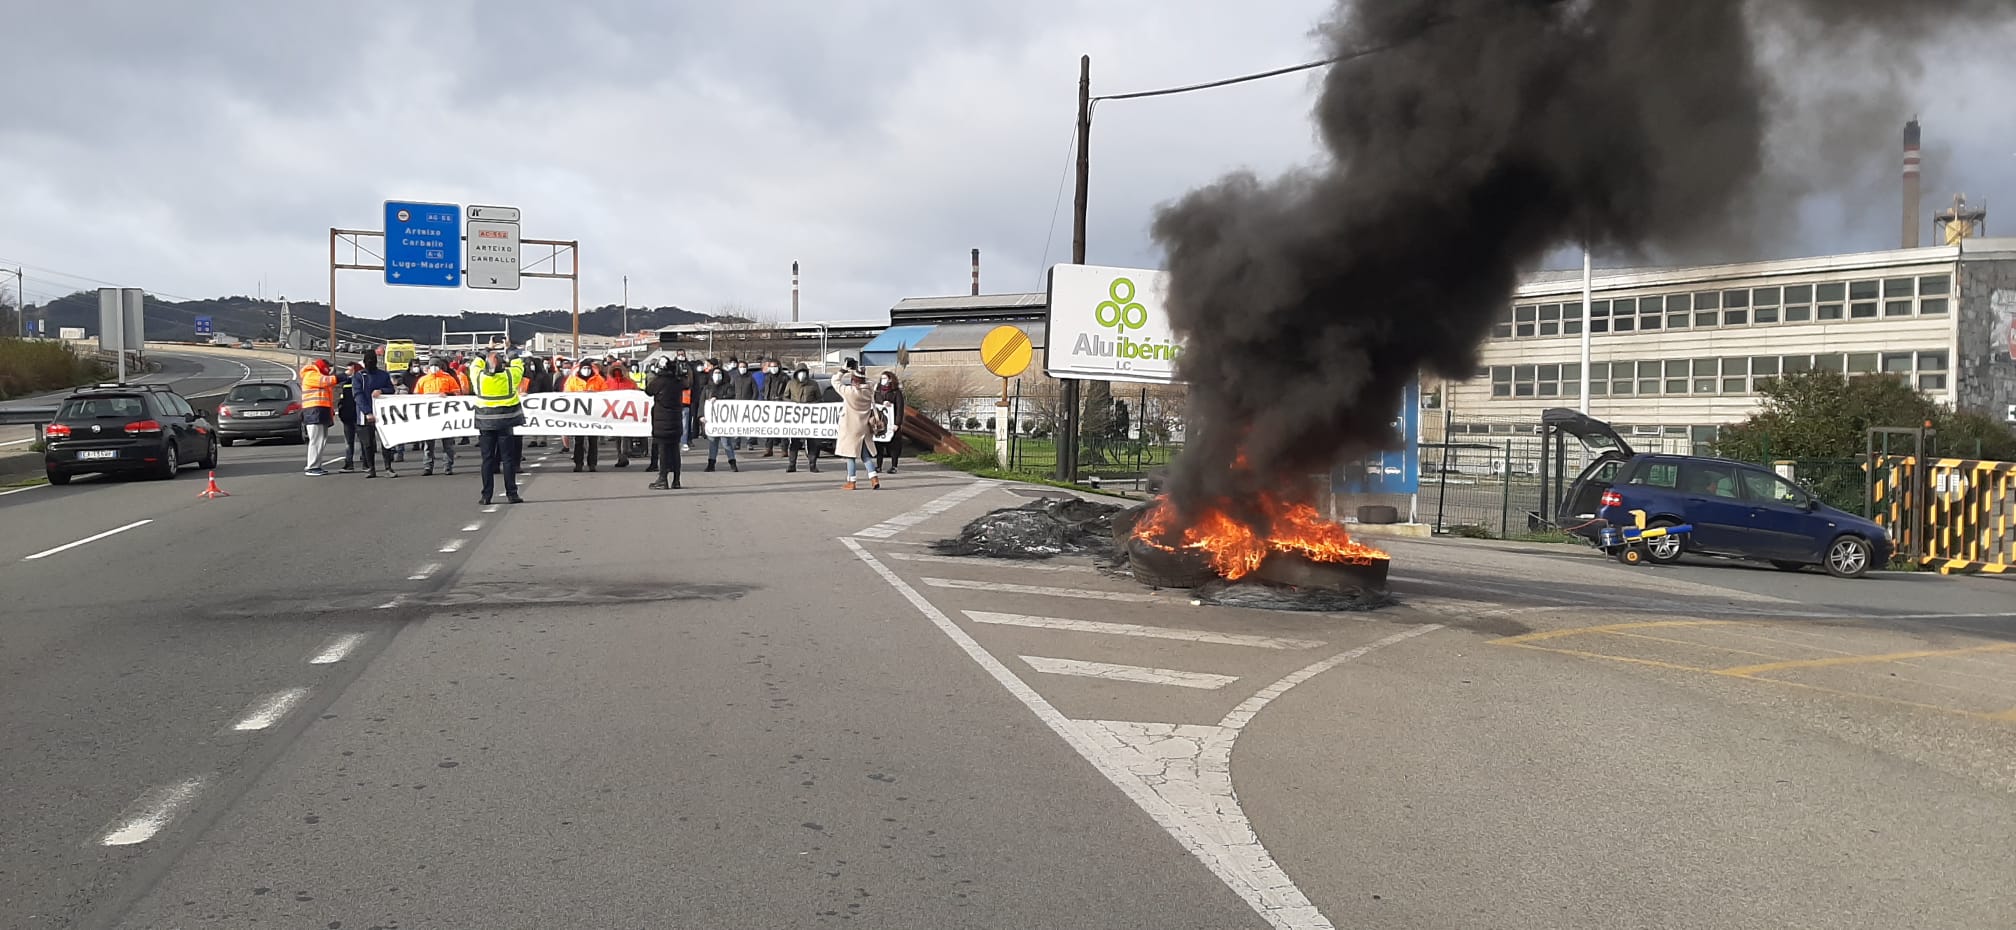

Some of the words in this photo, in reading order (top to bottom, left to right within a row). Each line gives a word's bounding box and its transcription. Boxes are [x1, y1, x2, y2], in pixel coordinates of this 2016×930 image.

[405, 227, 441, 236] Arteixo
[402, 238, 444, 247] Carballo
[471, 255, 516, 263] CARBALLO
[1116, 360, 1131, 371] LC
[601, 398, 649, 423] XA!
[711, 403, 739, 423] NON
[741, 404, 770, 424] AOS
[545, 418, 614, 430] CORUÑA
[737, 426, 780, 435] EMPREGO
[782, 427, 811, 436] DIGNO
[813, 428, 819, 436] E
